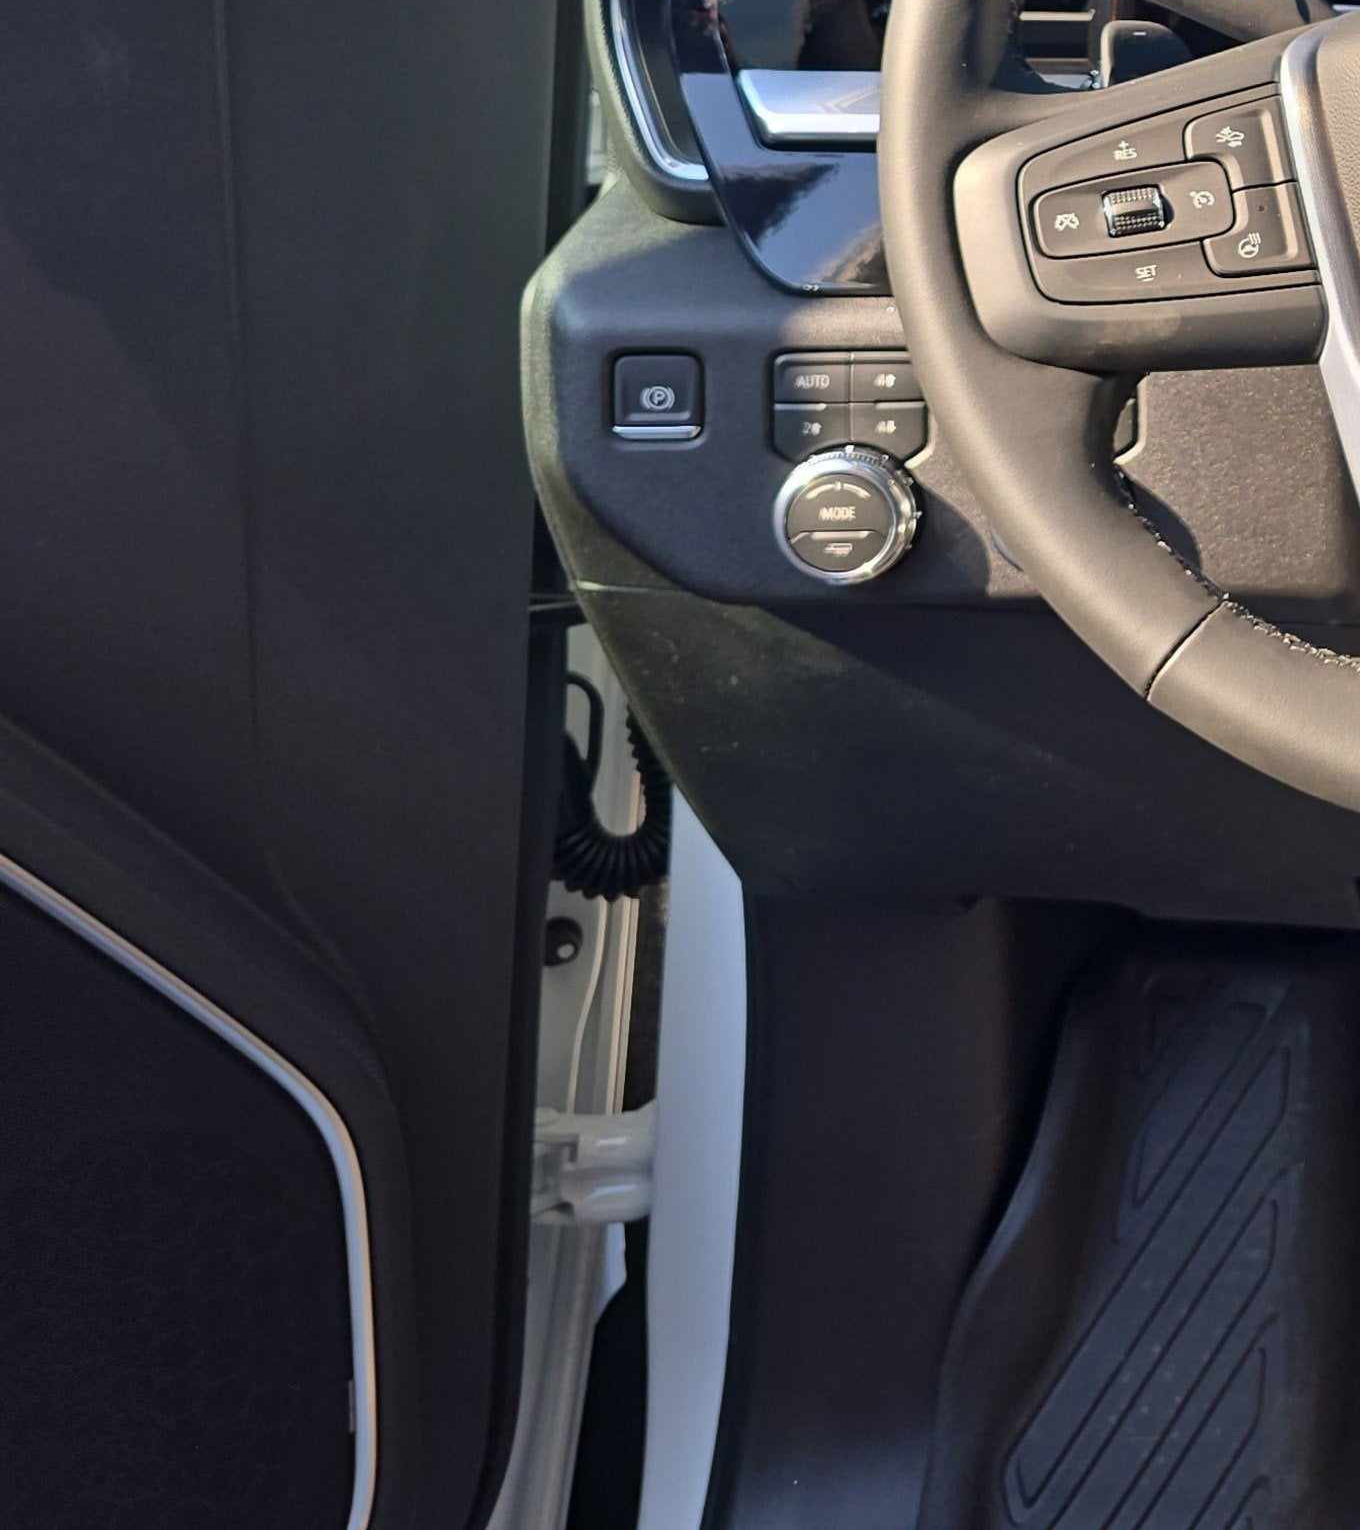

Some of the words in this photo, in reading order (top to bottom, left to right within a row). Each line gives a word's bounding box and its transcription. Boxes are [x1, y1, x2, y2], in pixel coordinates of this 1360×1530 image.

[1113, 148, 1138, 160] RES
[1135, 265, 1157, 279] SET
[795, 374, 830, 389] AUTO
[819, 506, 857, 520] MODE
